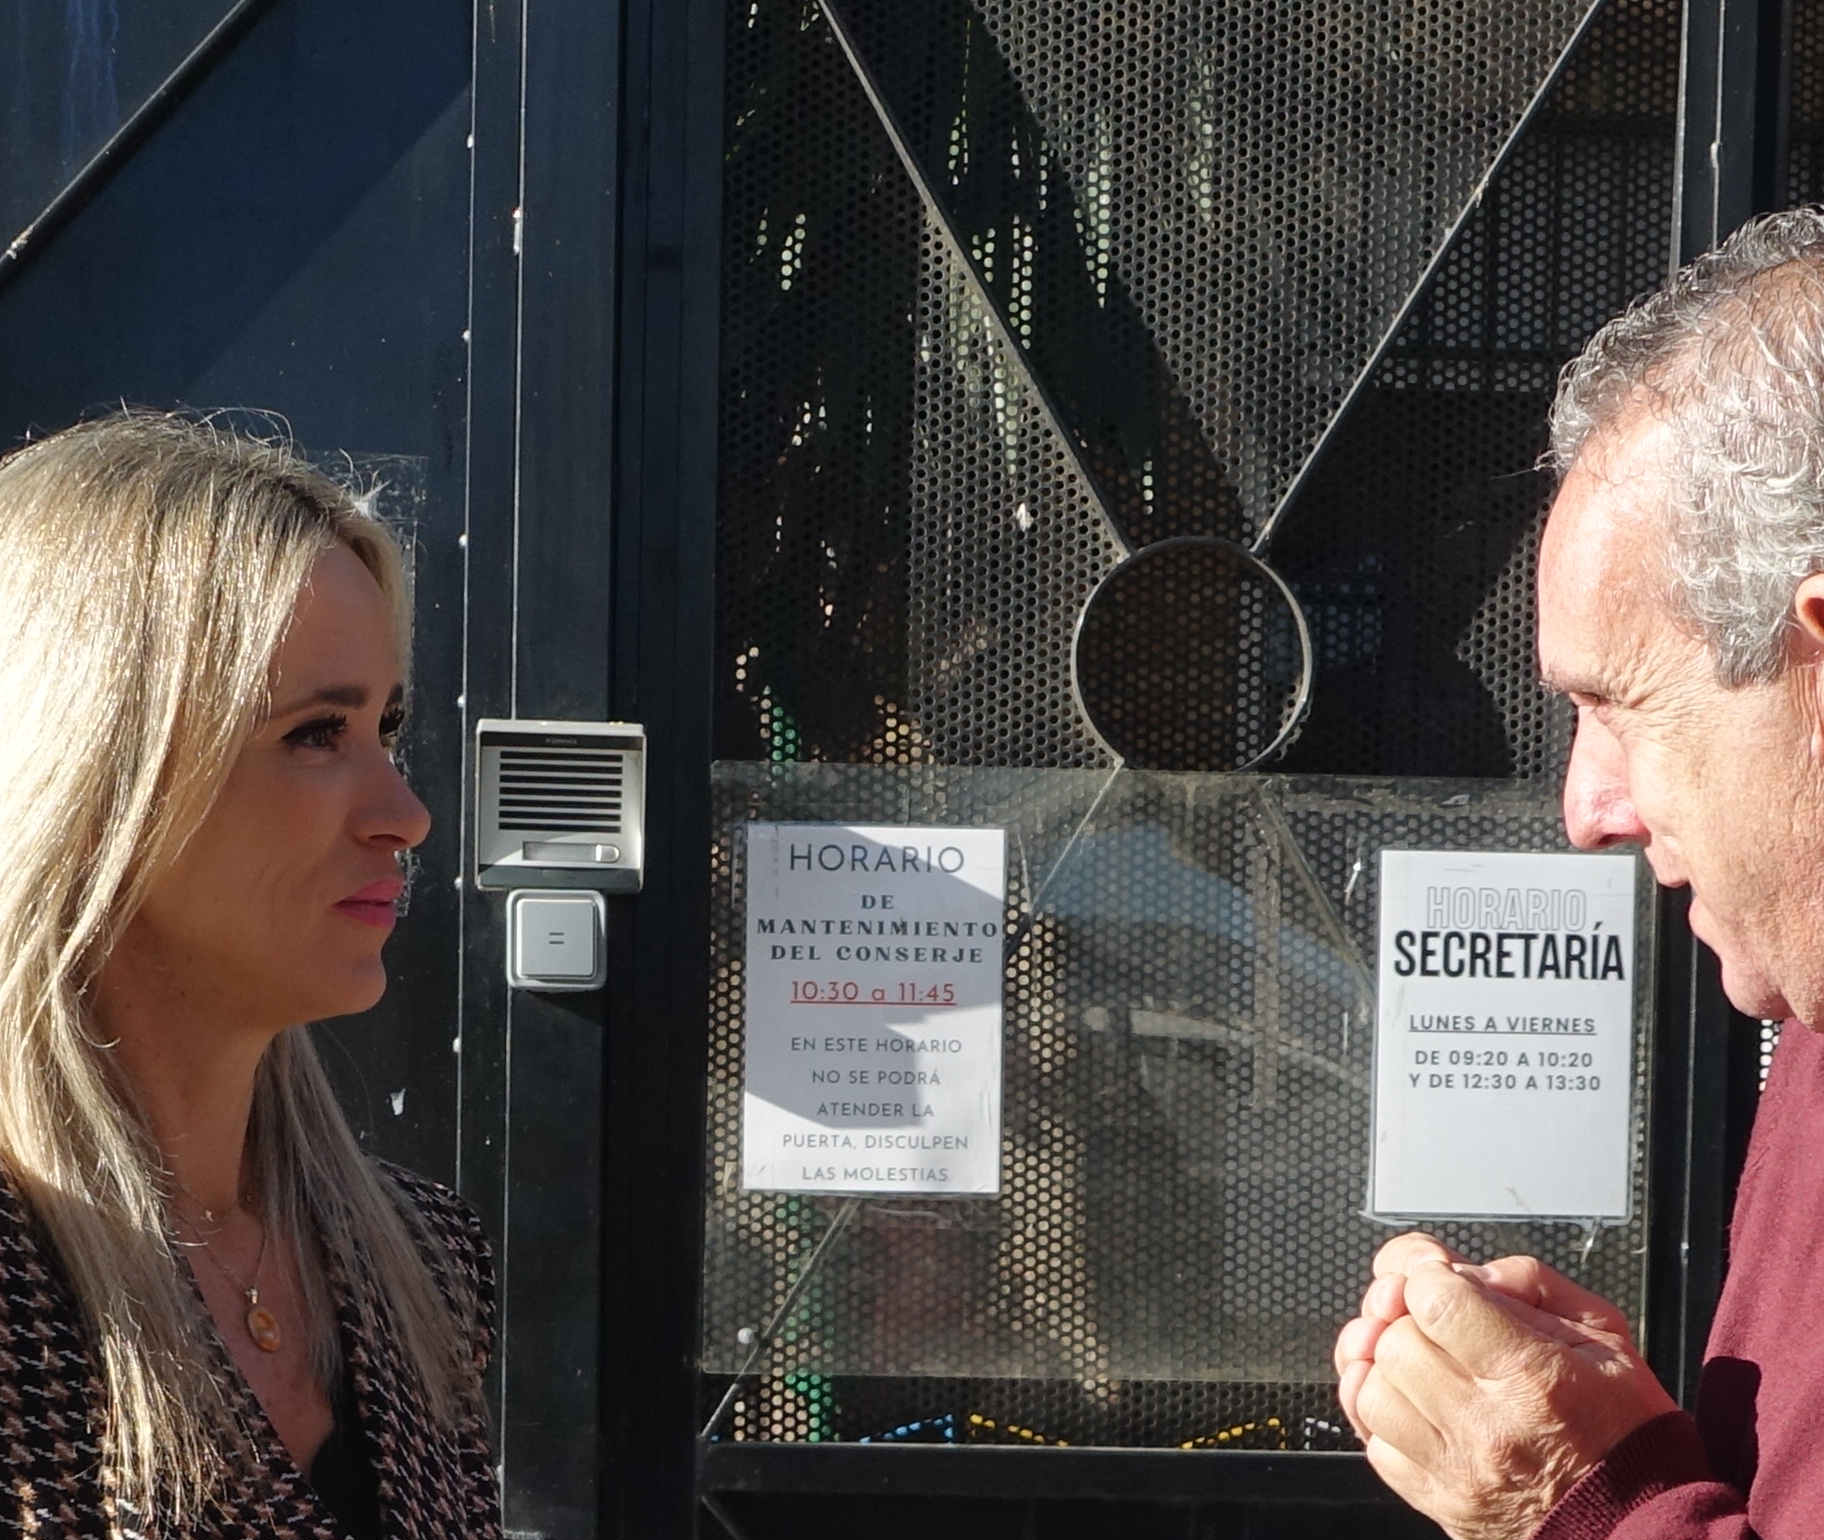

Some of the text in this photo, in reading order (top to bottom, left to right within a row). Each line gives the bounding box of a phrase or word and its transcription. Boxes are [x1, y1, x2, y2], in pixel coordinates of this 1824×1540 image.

[788, 843, 965, 874] HORARIO
[860, 894, 895, 910] DE
[1425, 886, 1587, 932] HORARIO
[756, 918, 998, 938] MANTENIMIENTO
[770, 944, 983, 964] DEL CONSERJE
[1393, 921, 1626, 981] SECRETARÍA
[790, 980, 956, 1003] 10:30 a 11:45
[1409, 1015, 1596, 1034] LUNES A VIERNES
[790, 1036, 962, 1054] EN ESTE HORARIO
[1414, 1049, 1593, 1068] DE 09:20 A 10:20
[811, 1066, 941, 1086] NO SE PODRÁ
[1408, 1073, 1602, 1091] Y DE 12:30 A 13:30
[816, 1102, 935, 1118] ATENDER LA
[782, 1133, 969, 1151] PUERTA, DISCULPEN
[801, 1166, 949, 1183] LAS MOLESTIAS
